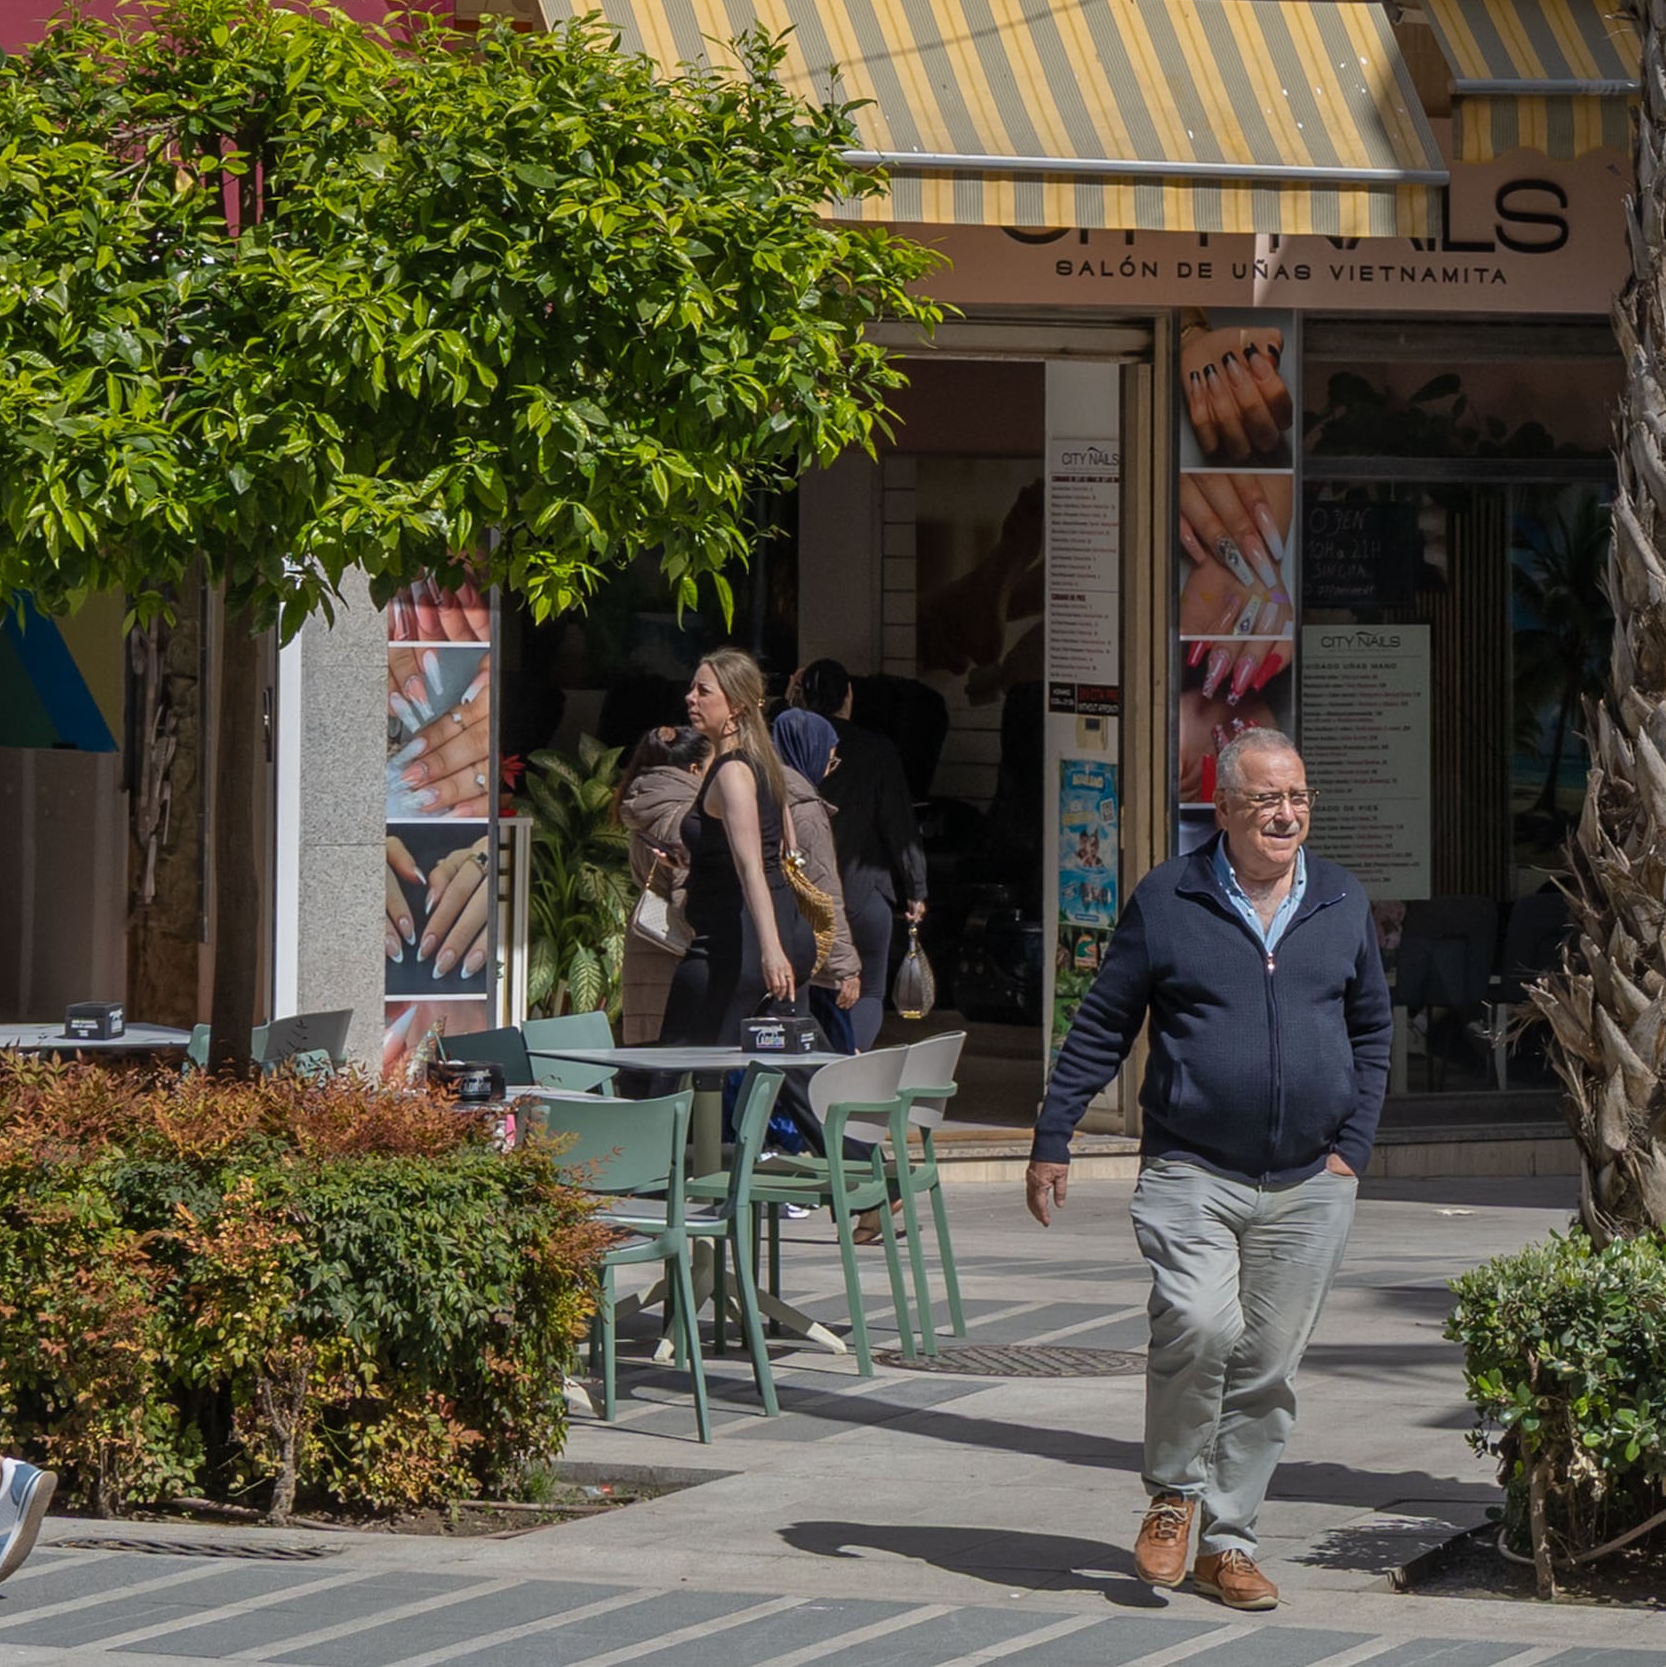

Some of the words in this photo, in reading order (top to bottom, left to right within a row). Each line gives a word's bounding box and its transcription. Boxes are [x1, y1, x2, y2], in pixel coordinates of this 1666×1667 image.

[1055, 254, 1159, 279] SALÓN
[1177, 260, 1214, 280] DE
[1232, 257, 1312, 282] UÑAS
[1329, 264, 1508, 285] VIETNAMITA
[1320, 635, 1355, 649] CITY
[1356, 634, 1402, 649] NAILS
